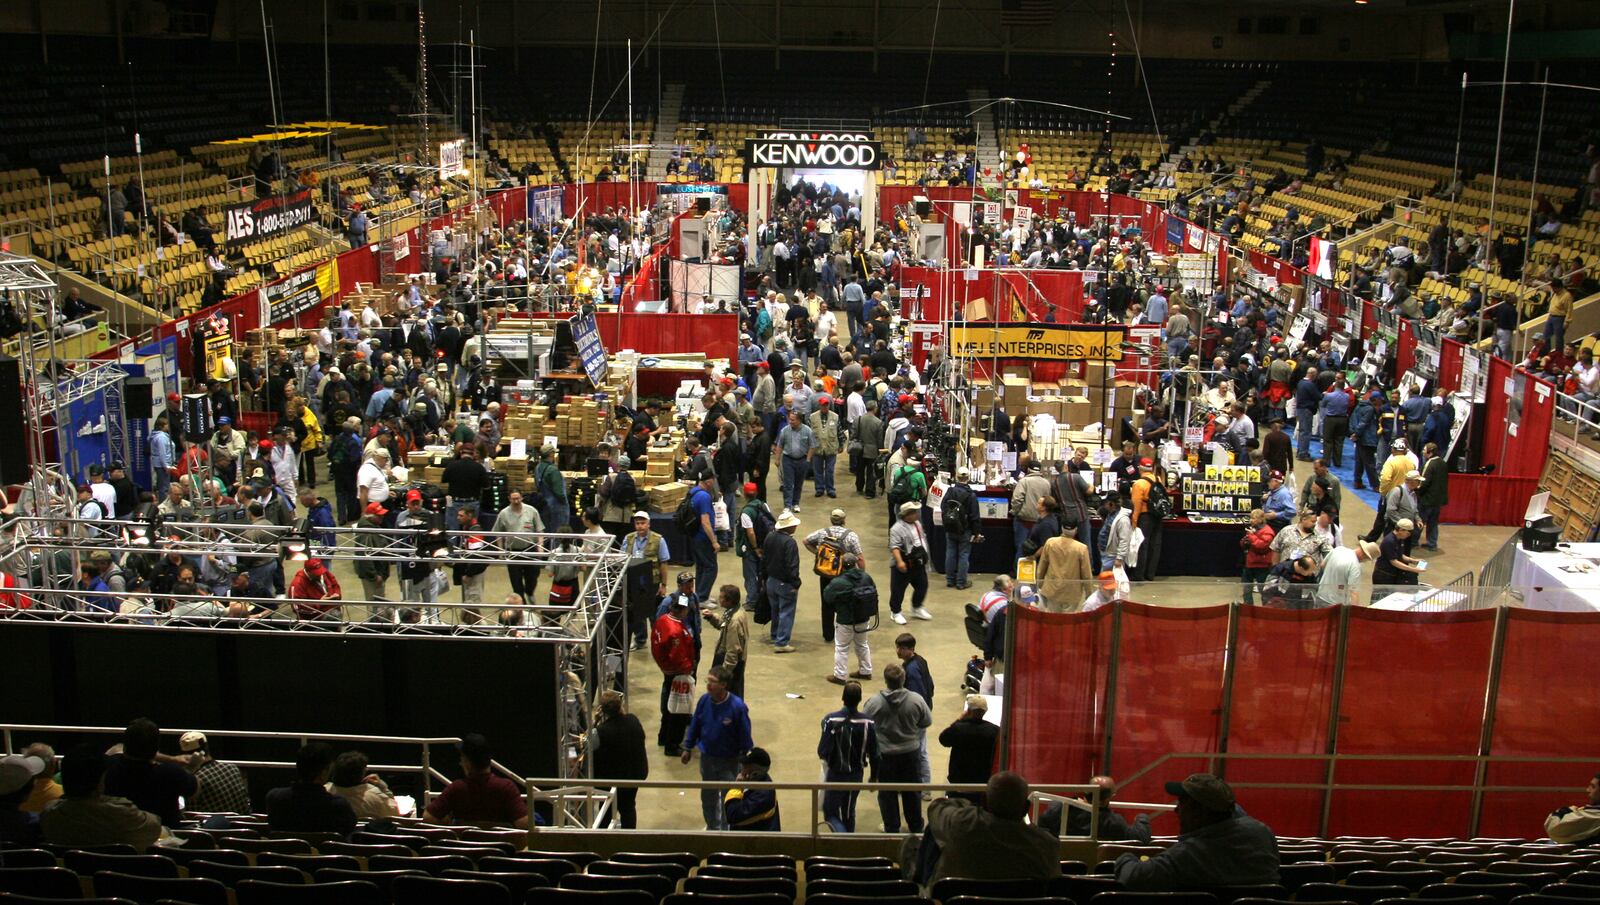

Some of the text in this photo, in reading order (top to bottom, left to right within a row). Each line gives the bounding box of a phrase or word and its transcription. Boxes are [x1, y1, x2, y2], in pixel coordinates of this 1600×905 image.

[753, 143, 875, 166] KENWOOD
[227, 206, 254, 241] AES
[1026, 330, 1045, 340] MFJ
[957, 342, 984, 354] MFJ
[1089, 345, 1115, 357] INC.
